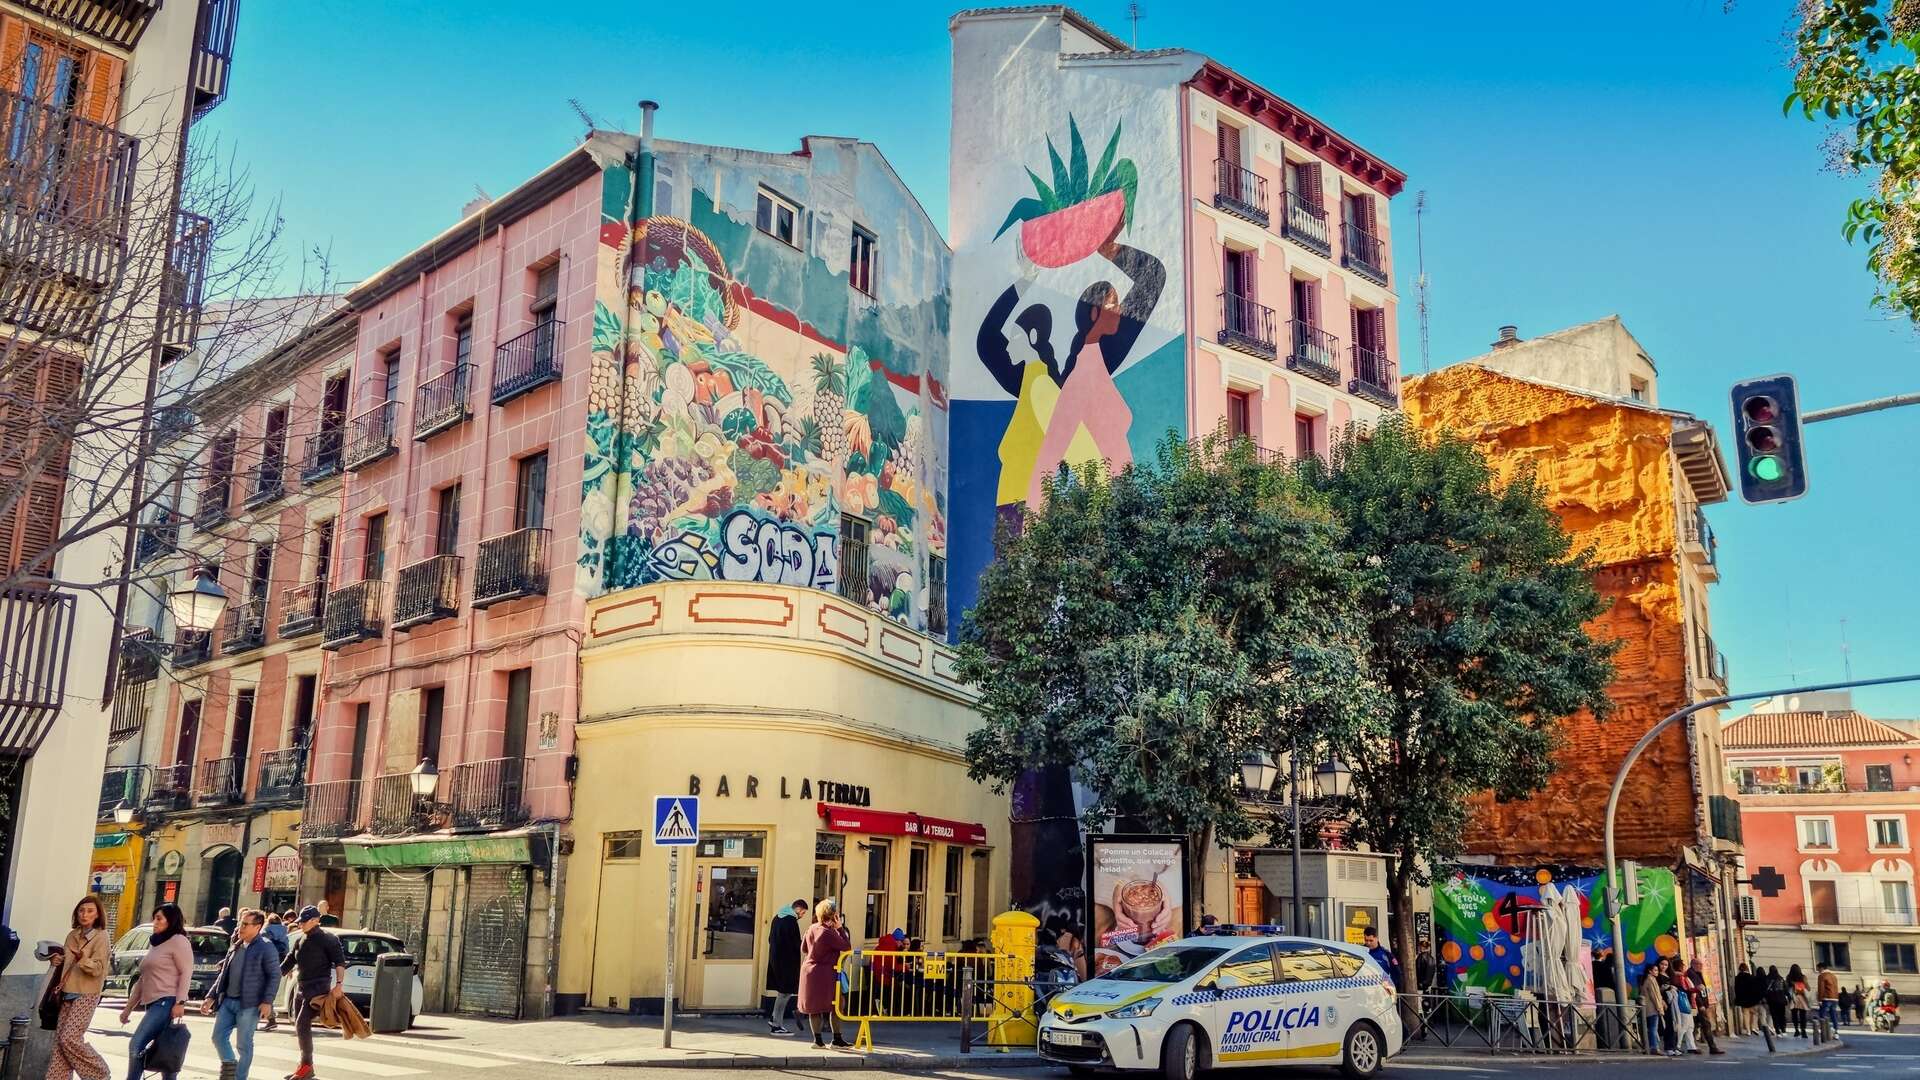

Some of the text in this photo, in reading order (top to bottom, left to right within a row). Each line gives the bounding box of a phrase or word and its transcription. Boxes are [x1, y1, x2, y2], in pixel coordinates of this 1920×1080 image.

[689, 774, 871, 807] BAR LA TERRAZA
[904, 822, 955, 838] BAR LA TERRAZA
[1152, 858, 1176, 867] vengo
[926, 964, 945, 974] PM
[1227, 1003, 1320, 1033] POLICÍA
[1221, 1030, 1281, 1044] MUNICIPAL
[1220, 1044, 1251, 1053] MADRID
